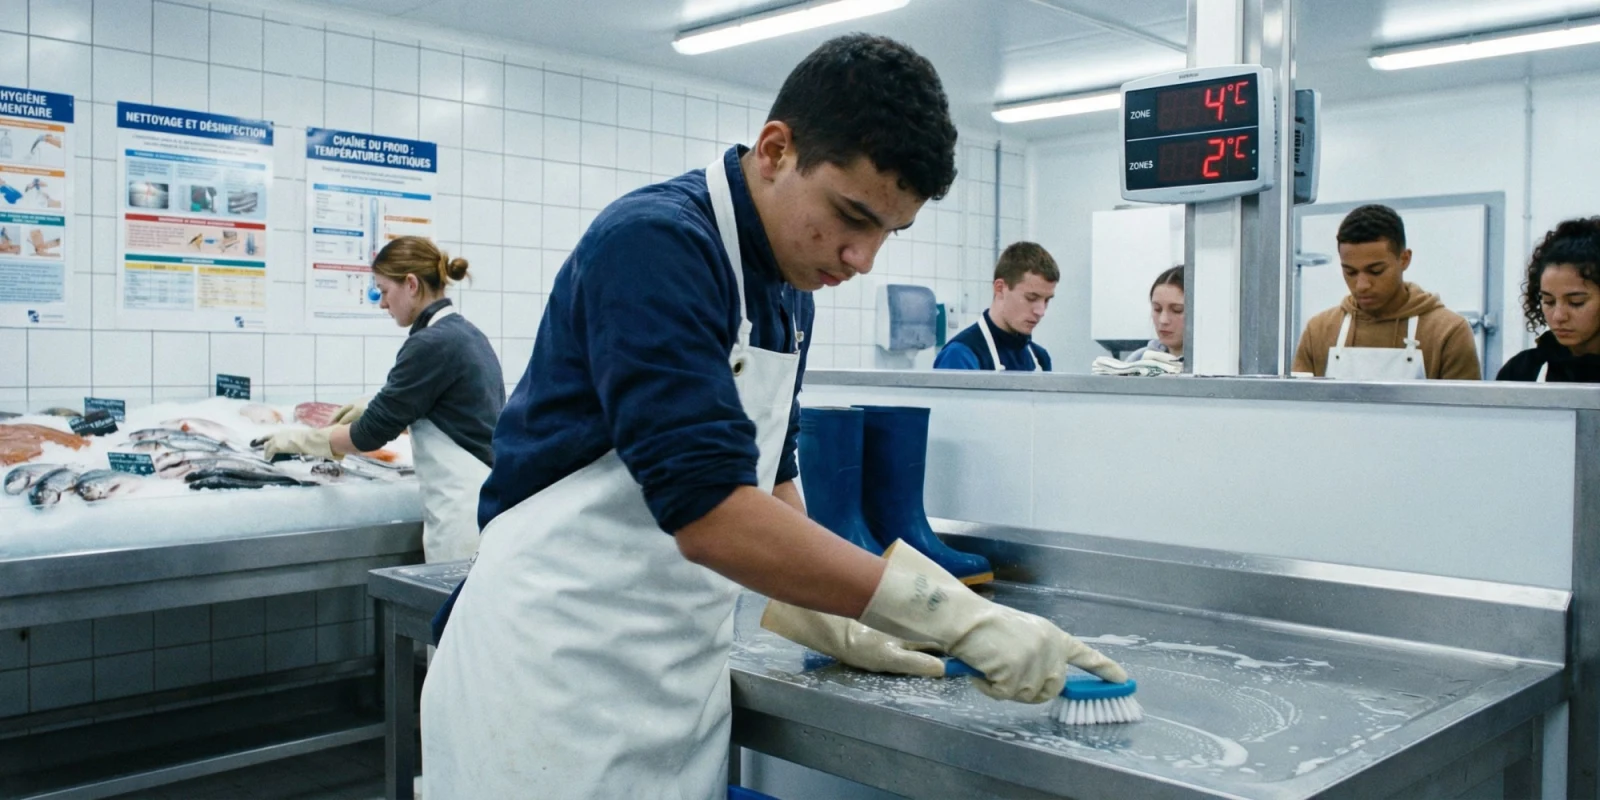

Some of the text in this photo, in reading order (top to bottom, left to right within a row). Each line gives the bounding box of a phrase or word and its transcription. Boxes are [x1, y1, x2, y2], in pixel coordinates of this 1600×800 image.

[0, 90, 48, 106] HYGIÈNE
[1204, 81, 1249, 121] 4°C
[0, 102, 53, 118] MENTAIRE
[1130, 109, 1151, 120] ZONE
[125, 111, 267, 139] NETTOYAGE ET DÉSINFECTION
[333, 135, 367, 149] CHAÎNE
[368, 139, 382, 151] DU
[382, 141, 409, 154] FROID
[314, 145, 432, 169] TEMPÉRATURES CRITIQUES
[1203, 135, 1249, 178] 2°C
